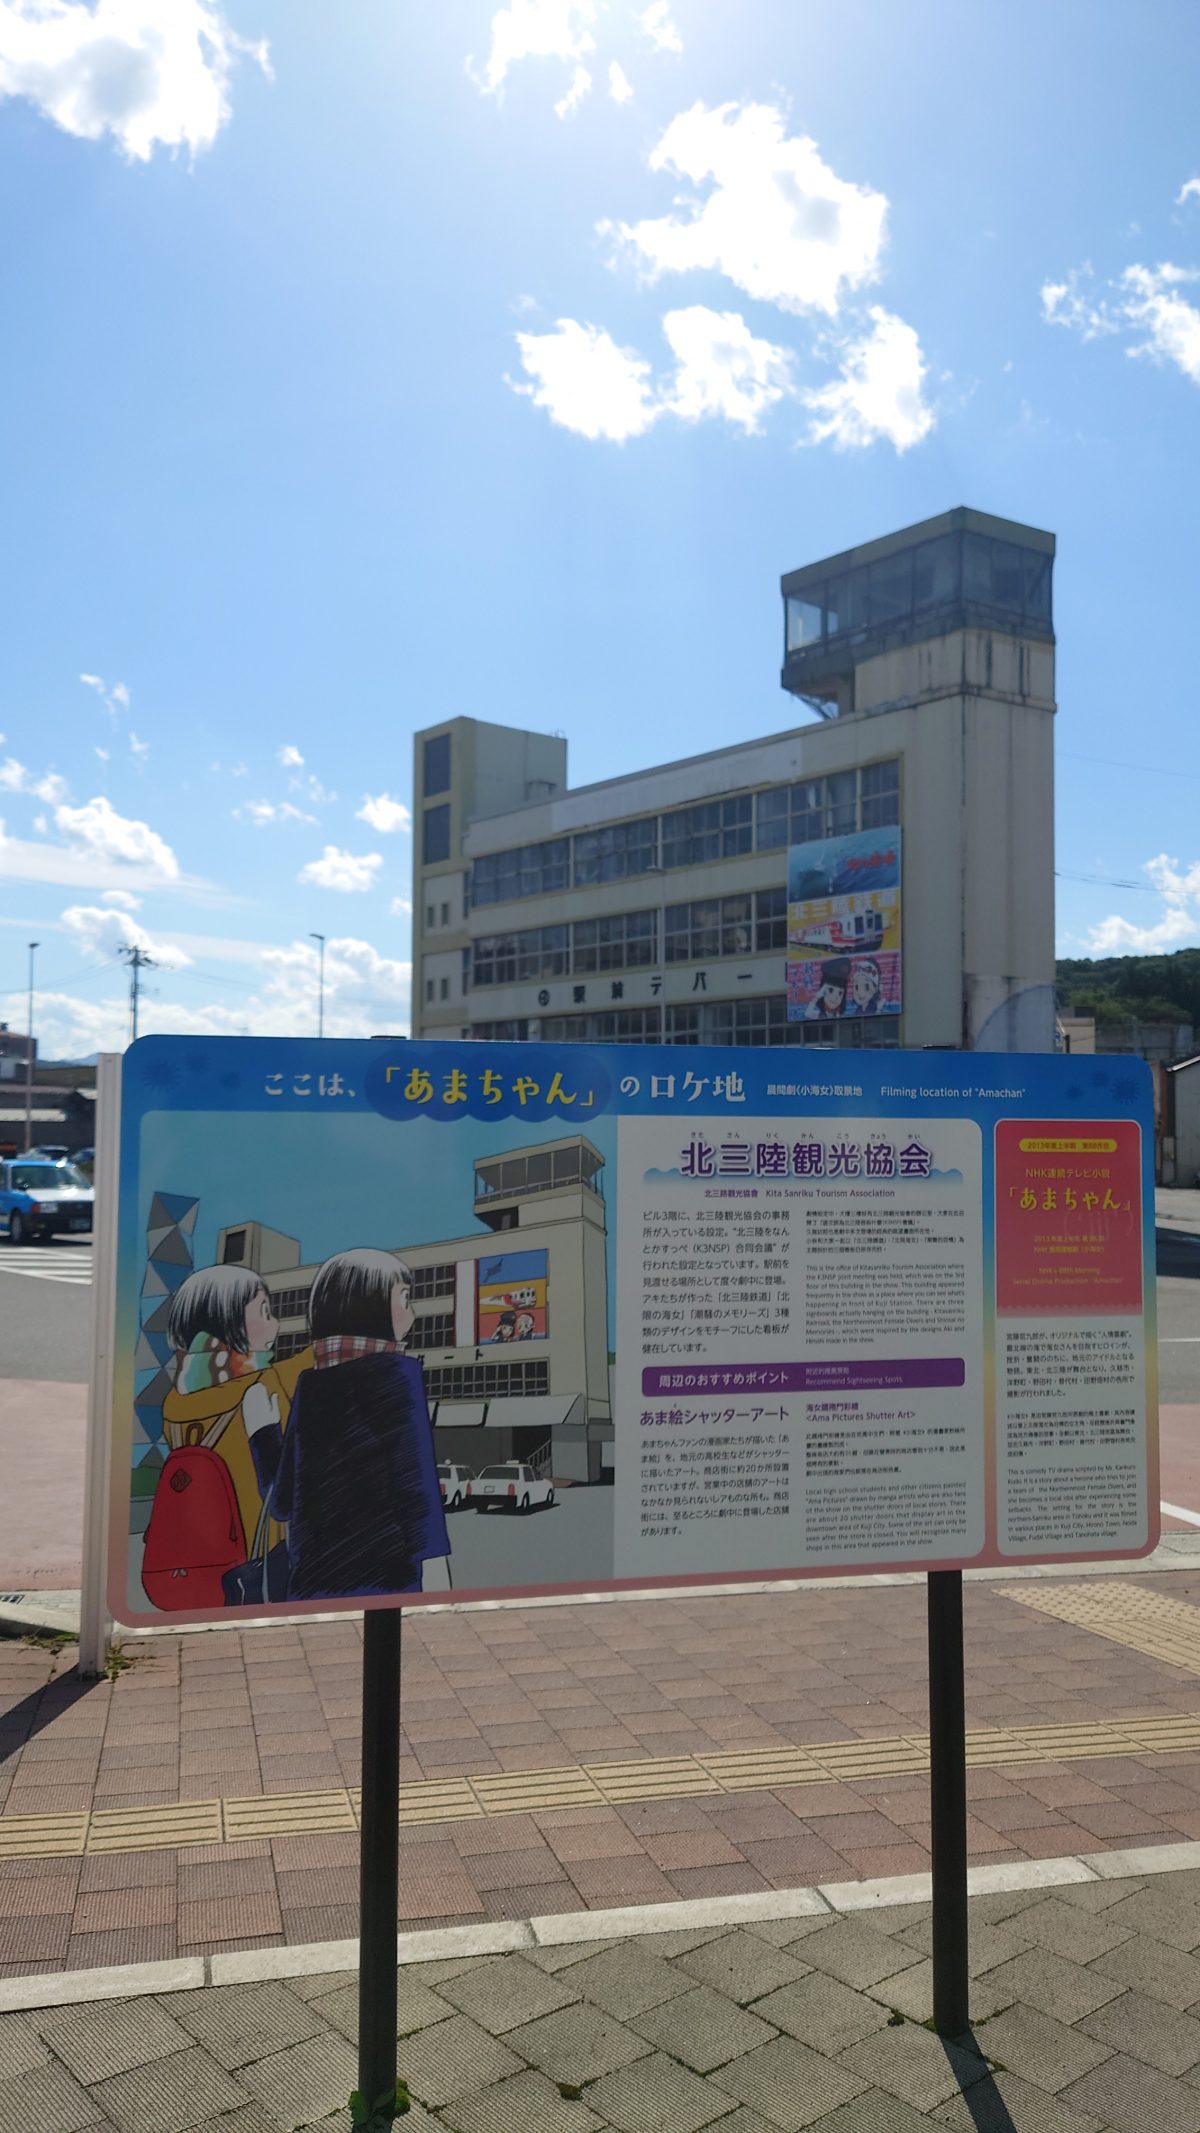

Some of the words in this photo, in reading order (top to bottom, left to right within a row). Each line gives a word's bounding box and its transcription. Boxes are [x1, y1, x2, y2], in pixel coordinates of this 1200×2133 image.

[880, 1086, 917, 1101] Filming
[919, 1087, 959, 1099] location
[961, 1087, 973, 1099] of
[680, 1140, 930, 1177] 北三陸観光協会
[766, 1188, 782, 1199] Kita
[784, 1188, 814, 1199] Sanriku
[816, 1188, 847, 1199] Tourism
[850, 1188, 895, 1199] Association
[1008, 1186, 1131, 1210] 「あまちゃん」
[658, 1370, 789, 1388] 周辺のおすすめポイント
[846, 1375, 883, 1386] Sightseeing
[884, 1375, 903, 1384] Spots
[640, 1405, 789, 1426] あま絵シャッターアート
[832, 1412, 863, 1421] Pictures
[866, 1410, 894, 1420] Shutter
